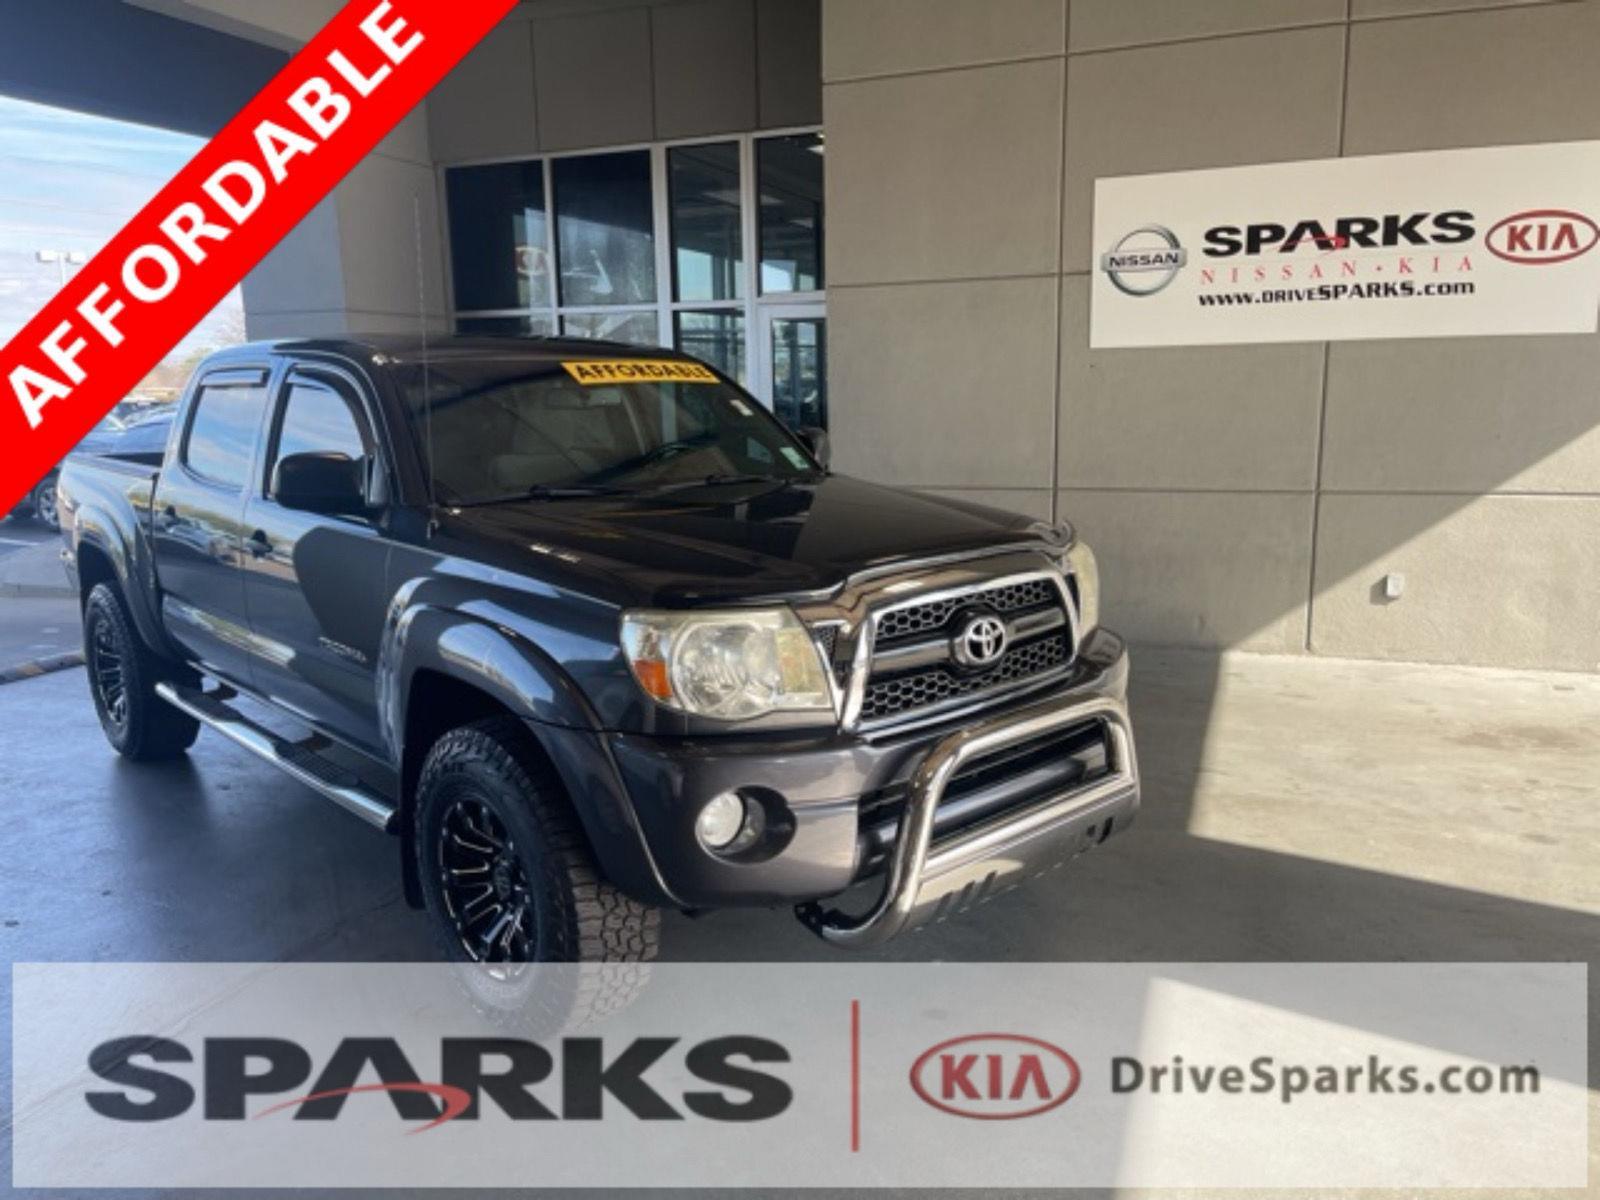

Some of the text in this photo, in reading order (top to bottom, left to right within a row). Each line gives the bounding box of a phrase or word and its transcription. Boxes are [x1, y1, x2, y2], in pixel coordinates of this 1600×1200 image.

[1202, 210, 1475, 258] SPARKS
[1506, 222, 1580, 252] KIA
[1108, 252, 1179, 268] NISSAN
[1201, 255, 1474, 284] NISSAN KIA
[575, 363, 713, 379] AFFORDABLE
